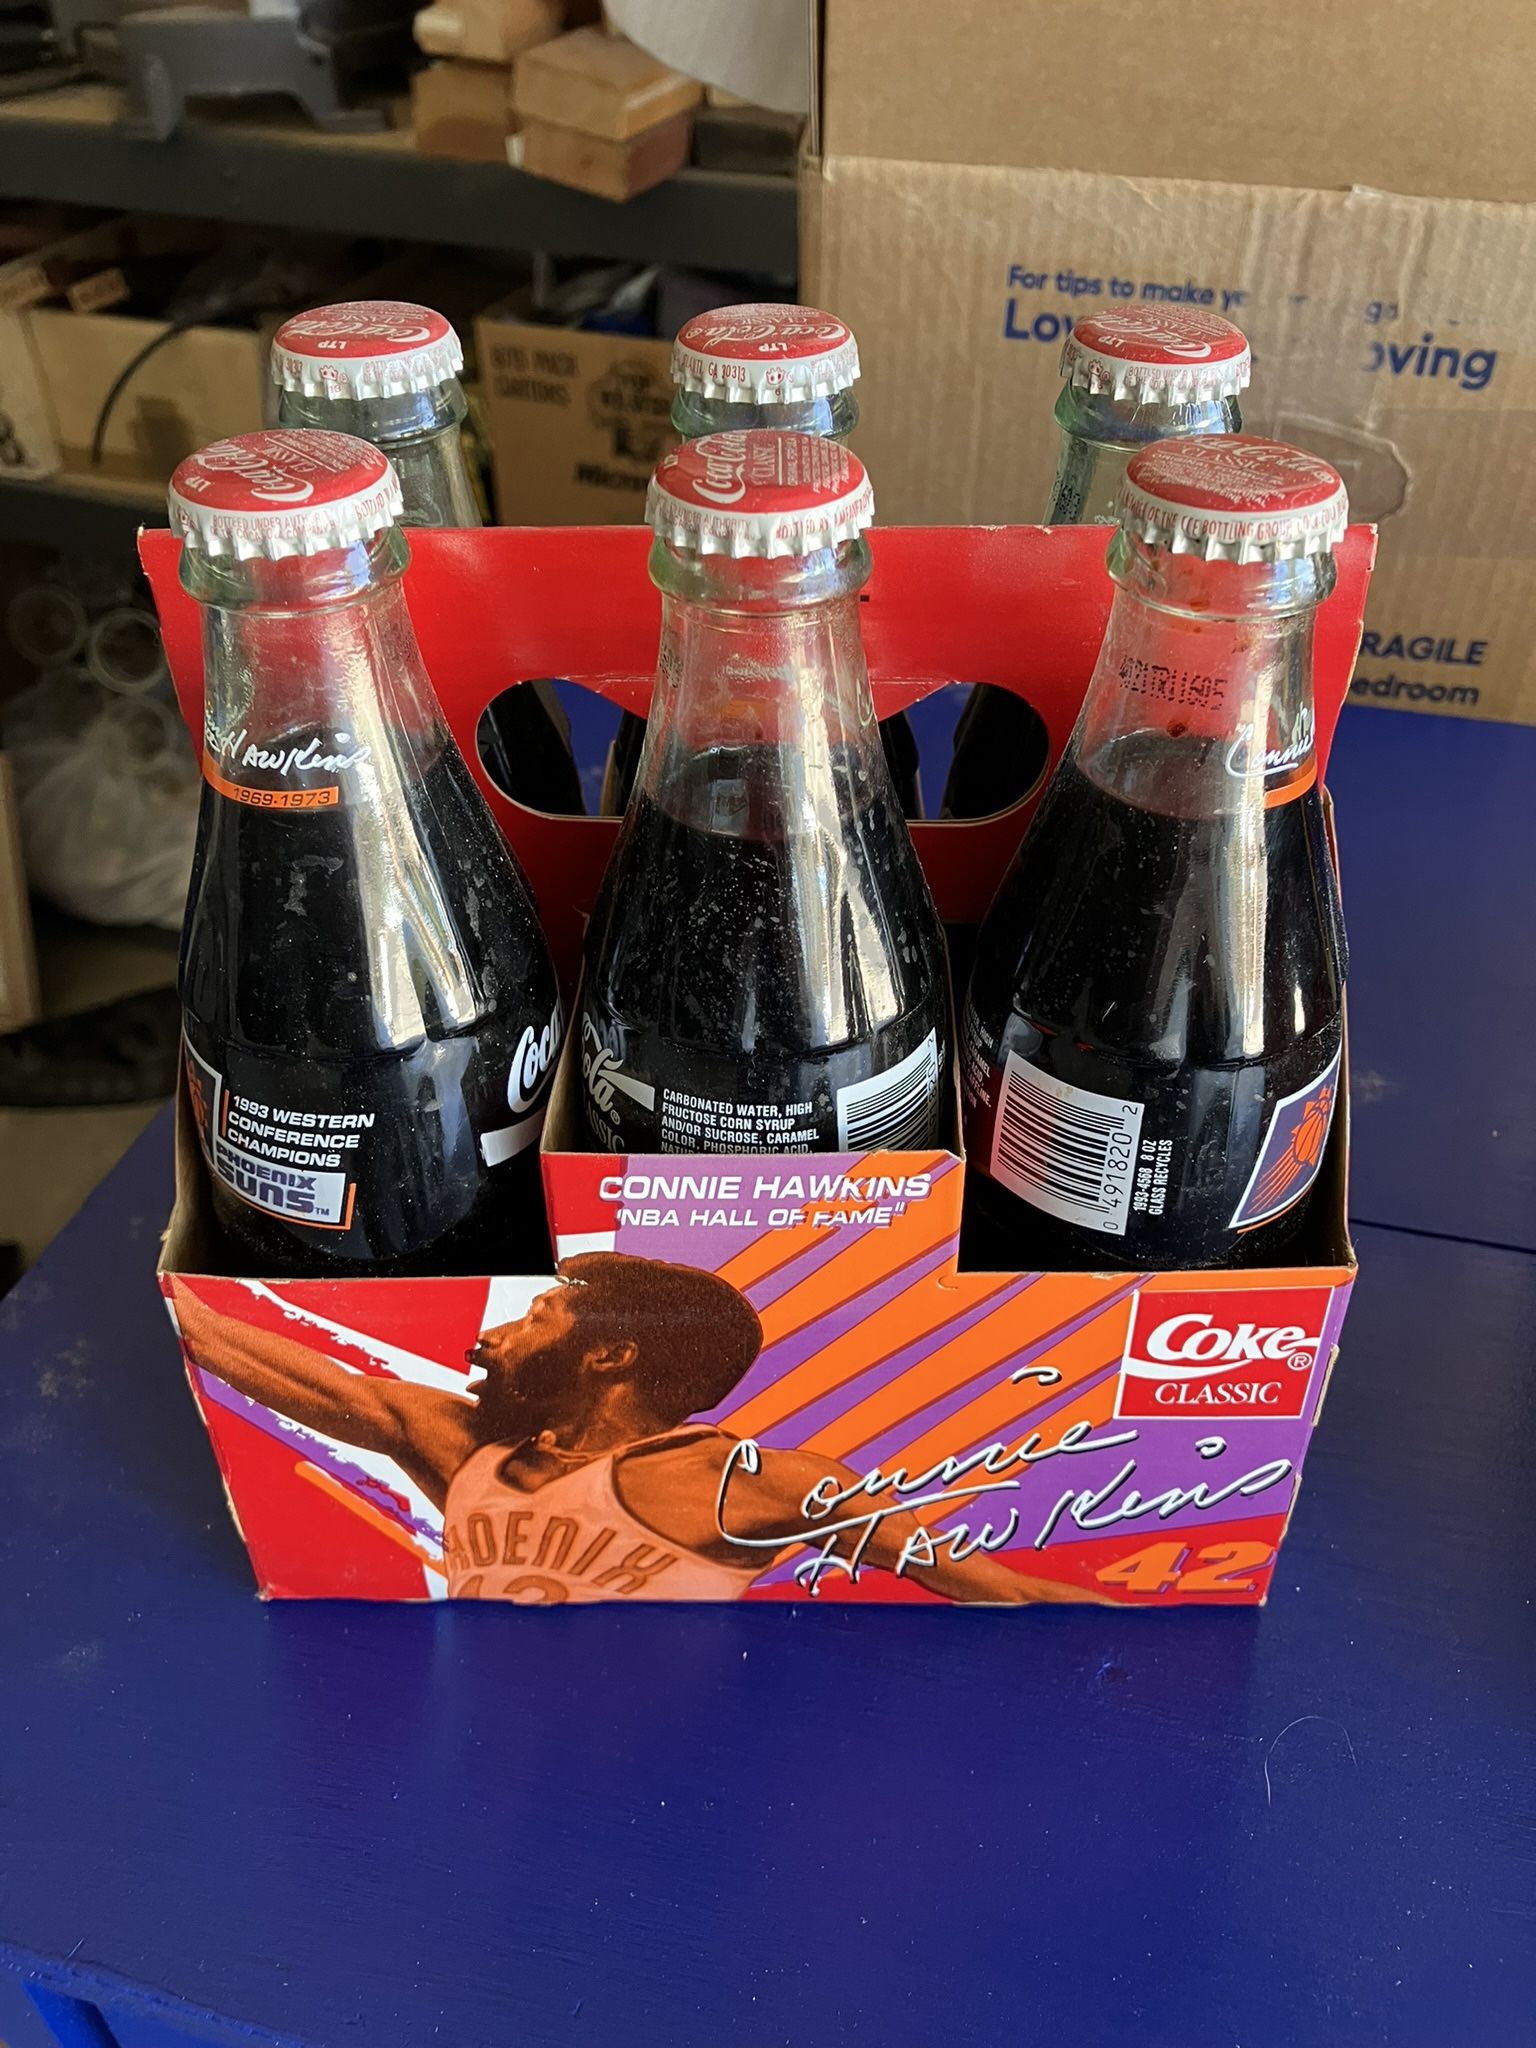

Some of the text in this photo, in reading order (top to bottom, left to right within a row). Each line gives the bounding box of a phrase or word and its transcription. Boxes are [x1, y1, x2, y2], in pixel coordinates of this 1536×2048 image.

[1007, 264, 1048, 290] For
[1056, 269, 1104, 297] tips
[1109, 277, 1134, 297] to
[1141, 279, 1215, 305] make
[758, 342, 788, 353] LTP
[1202, 519, 1254, 541] BOTTLING
[1350, 674, 1480, 706] edroom
[233, 1095, 376, 1129] 1993 WESTERN
[662, 1101, 796, 1131] FRUCTOSE CORN SYRUP
[663, 1087, 813, 1119] CARBONATED WATER, HIGH
[228, 1110, 361, 1150] CONFERENCE
[661, 1115, 820, 1145] AND/OR SUCROSE, CARAMEL
[661, 1128, 700, 1150] COLOR,
[227, 1127, 342, 1168] CHAMPIONS
[1102, 1132, 1133, 1209] 491820
[1122, 1104, 1138, 1116] 2
[1141, 1153, 1155, 1161] 8
[1142, 1139, 1157, 1153] OZ
[599, 1173, 932, 1203] CONNIE HAWKINS
[1148, 1139, 1174, 1216] GLASS RECYCLES
[689, 1207, 759, 1227] HALL
[767, 1207, 805, 1228] OF
[1154, 1381, 1282, 1405] CLASSIC
[716, 1366, 1139, 1547] Connie
[1094, 1541, 1276, 1593] 42
